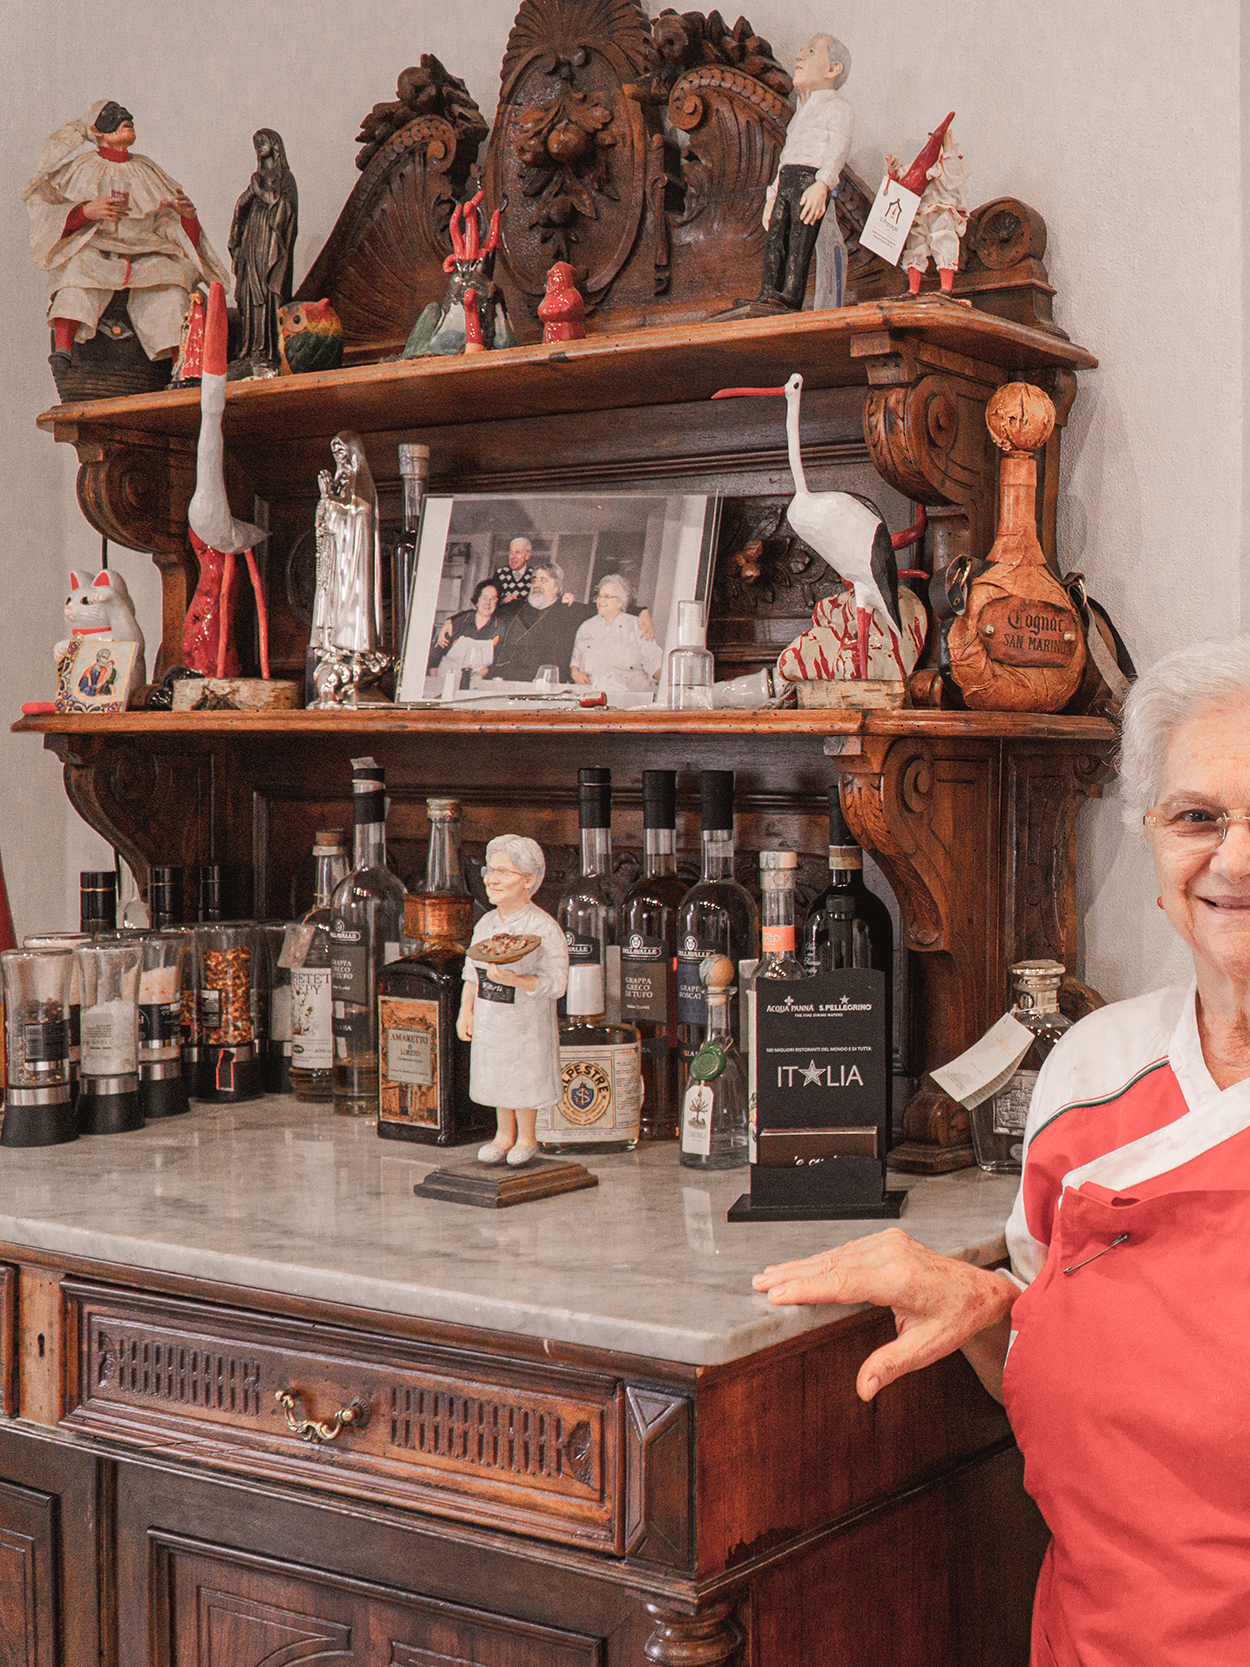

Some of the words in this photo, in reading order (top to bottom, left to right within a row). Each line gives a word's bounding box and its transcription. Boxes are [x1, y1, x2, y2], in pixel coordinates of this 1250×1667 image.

[1008, 607, 1063, 635] Cognac
[1003, 633, 1024, 648] SAN
[1029, 636, 1067, 654] MARINO
[625, 976, 652, 985] GRAPPA
[626, 983, 650, 992] GRECO
[680, 984, 701, 993] GRAPP
[632, 991, 654, 999] TUFO
[678, 991, 702, 1000] MOSCAT
[766, 1004, 790, 1014] ACQUA
[790, 1004, 815, 1012] PANNA
[391, 1033, 429, 1045] AMARETTO
